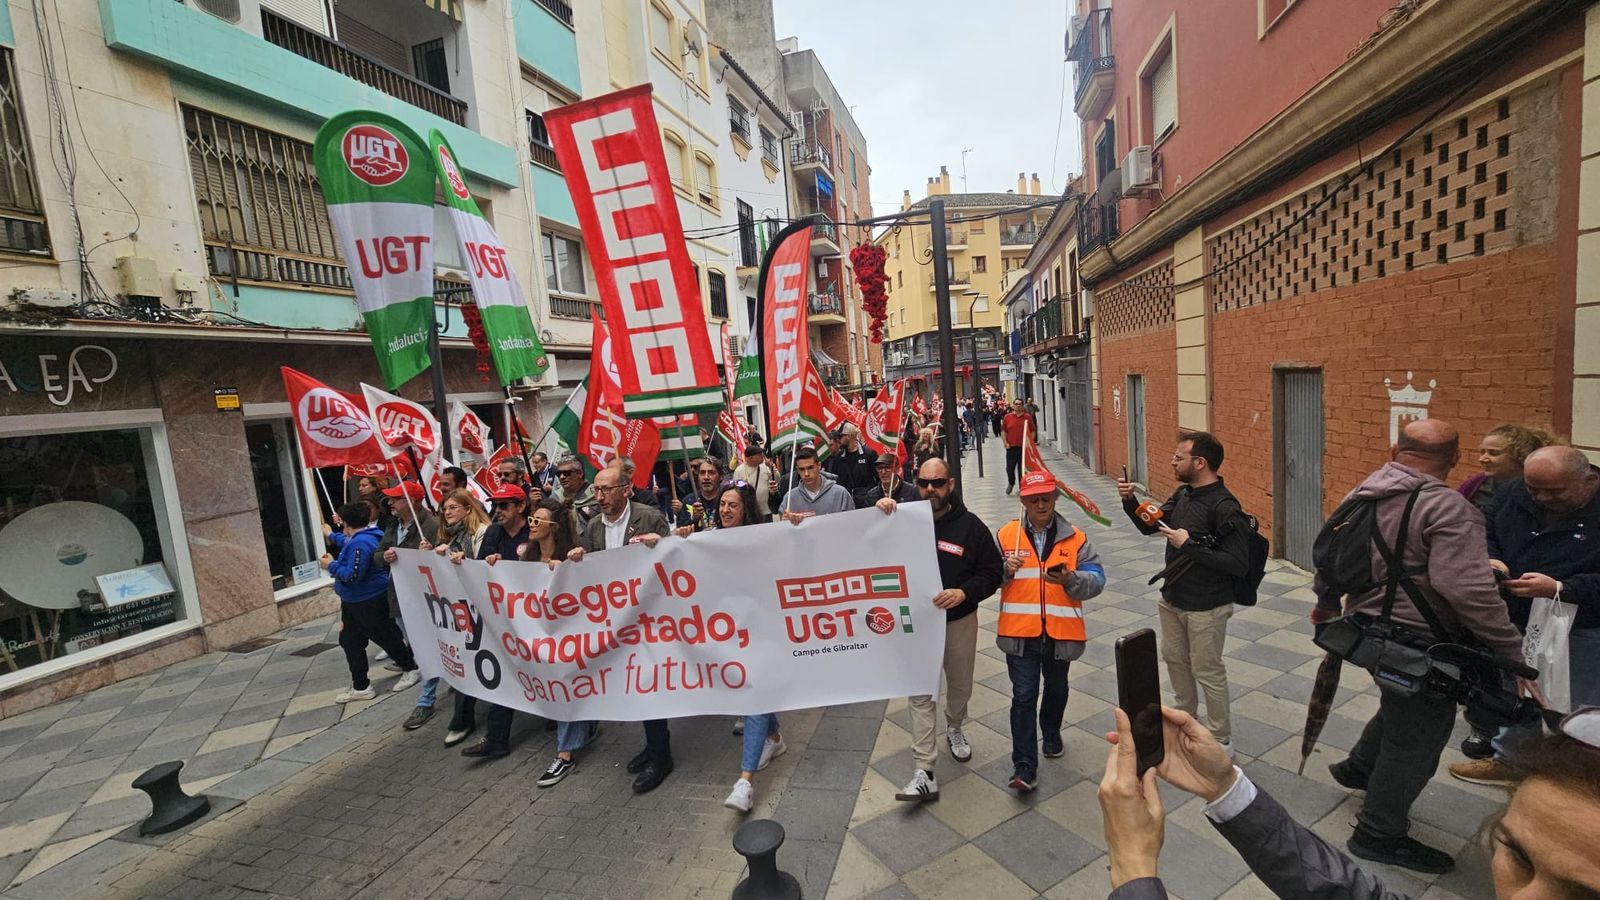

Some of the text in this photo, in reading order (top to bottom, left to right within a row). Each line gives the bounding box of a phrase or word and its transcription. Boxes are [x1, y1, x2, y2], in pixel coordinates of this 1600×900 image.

[351, 134, 398, 163] UGT
[356, 236, 430, 279] UGT
[465, 241, 510, 281] UGT
[571, 108, 697, 392] CCOO
[773, 263, 802, 416] CCOO
[378, 407, 425, 438] UGT
[418, 566, 440, 598] 1
[487, 562, 696, 624] Proteger lo
[784, 575, 867, 603] CCOO
[502, 605, 750, 670] conquistado,
[784, 608, 858, 643] UGT
[793, 642, 869, 658] Campo de Gibraltar
[518, 652, 747, 703] ganar futuro
